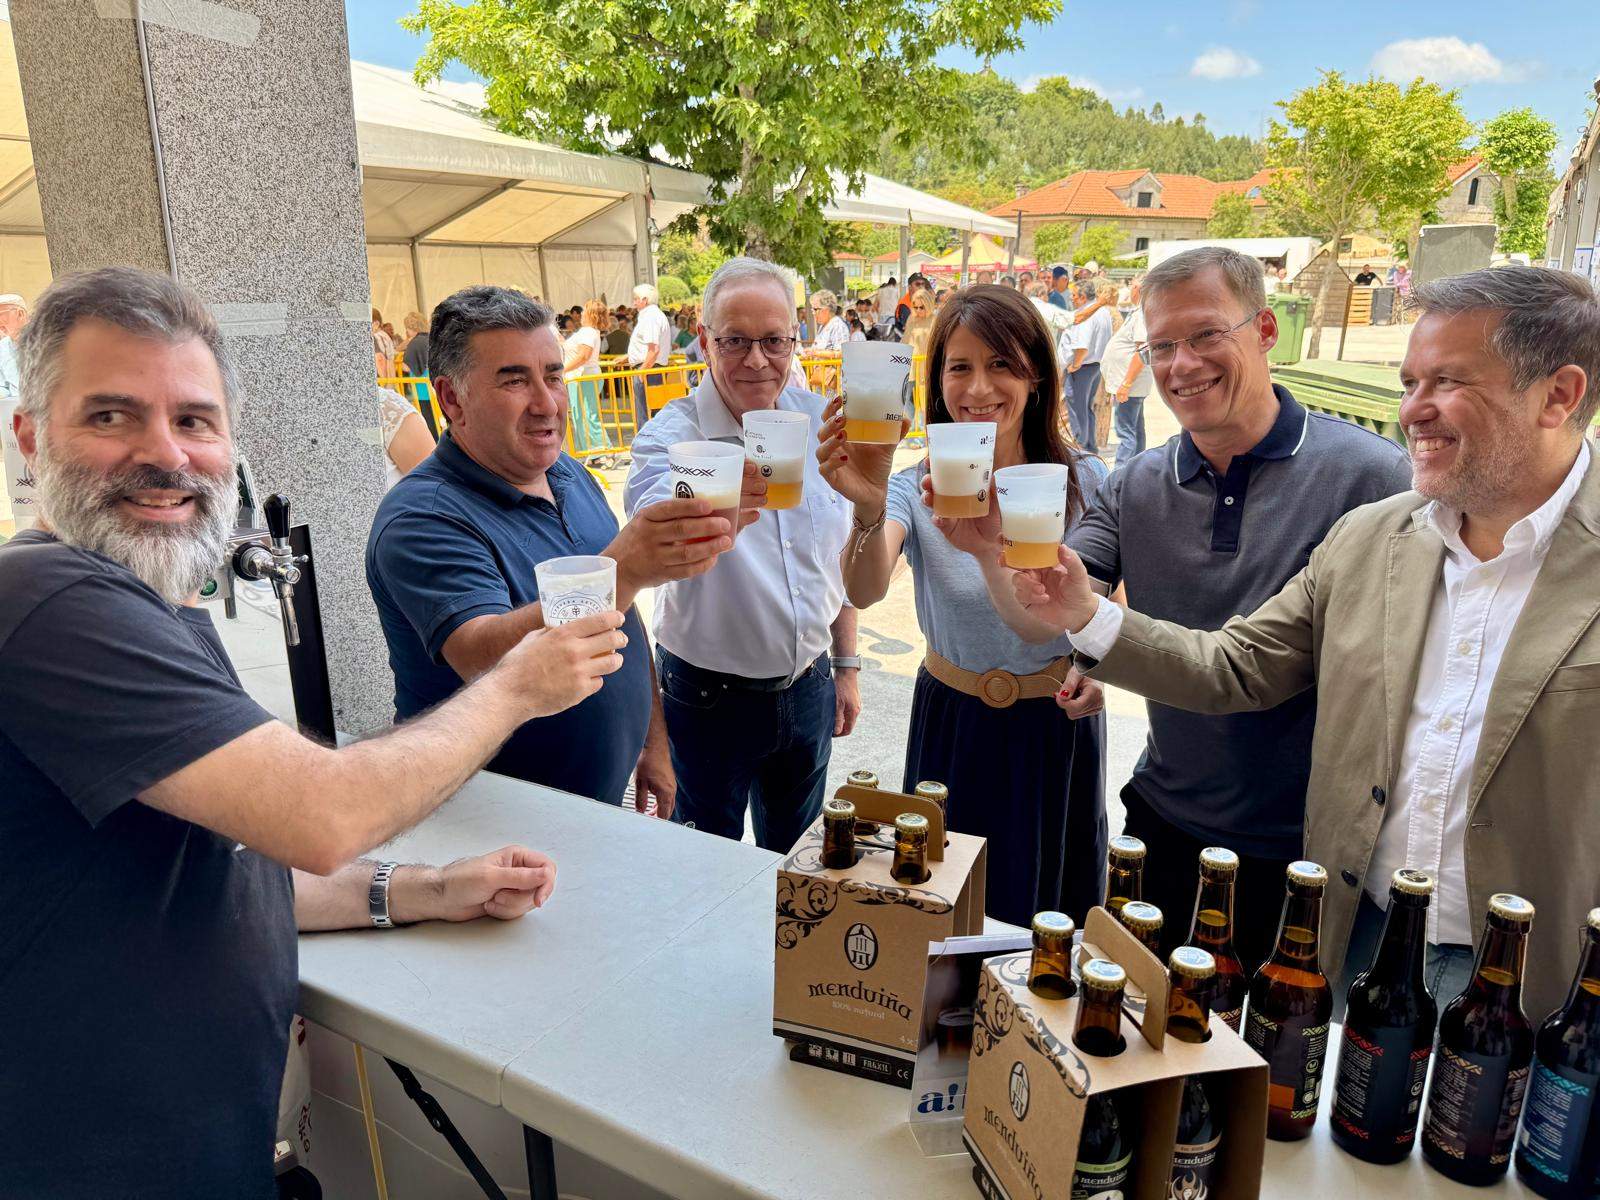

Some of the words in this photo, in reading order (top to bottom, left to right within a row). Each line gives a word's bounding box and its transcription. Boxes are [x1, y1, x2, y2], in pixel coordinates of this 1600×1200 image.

[808, 980, 912, 1020] menduiña
[853, 1007, 885, 1020] natural
[984, 1106, 1043, 1200] menduiña
